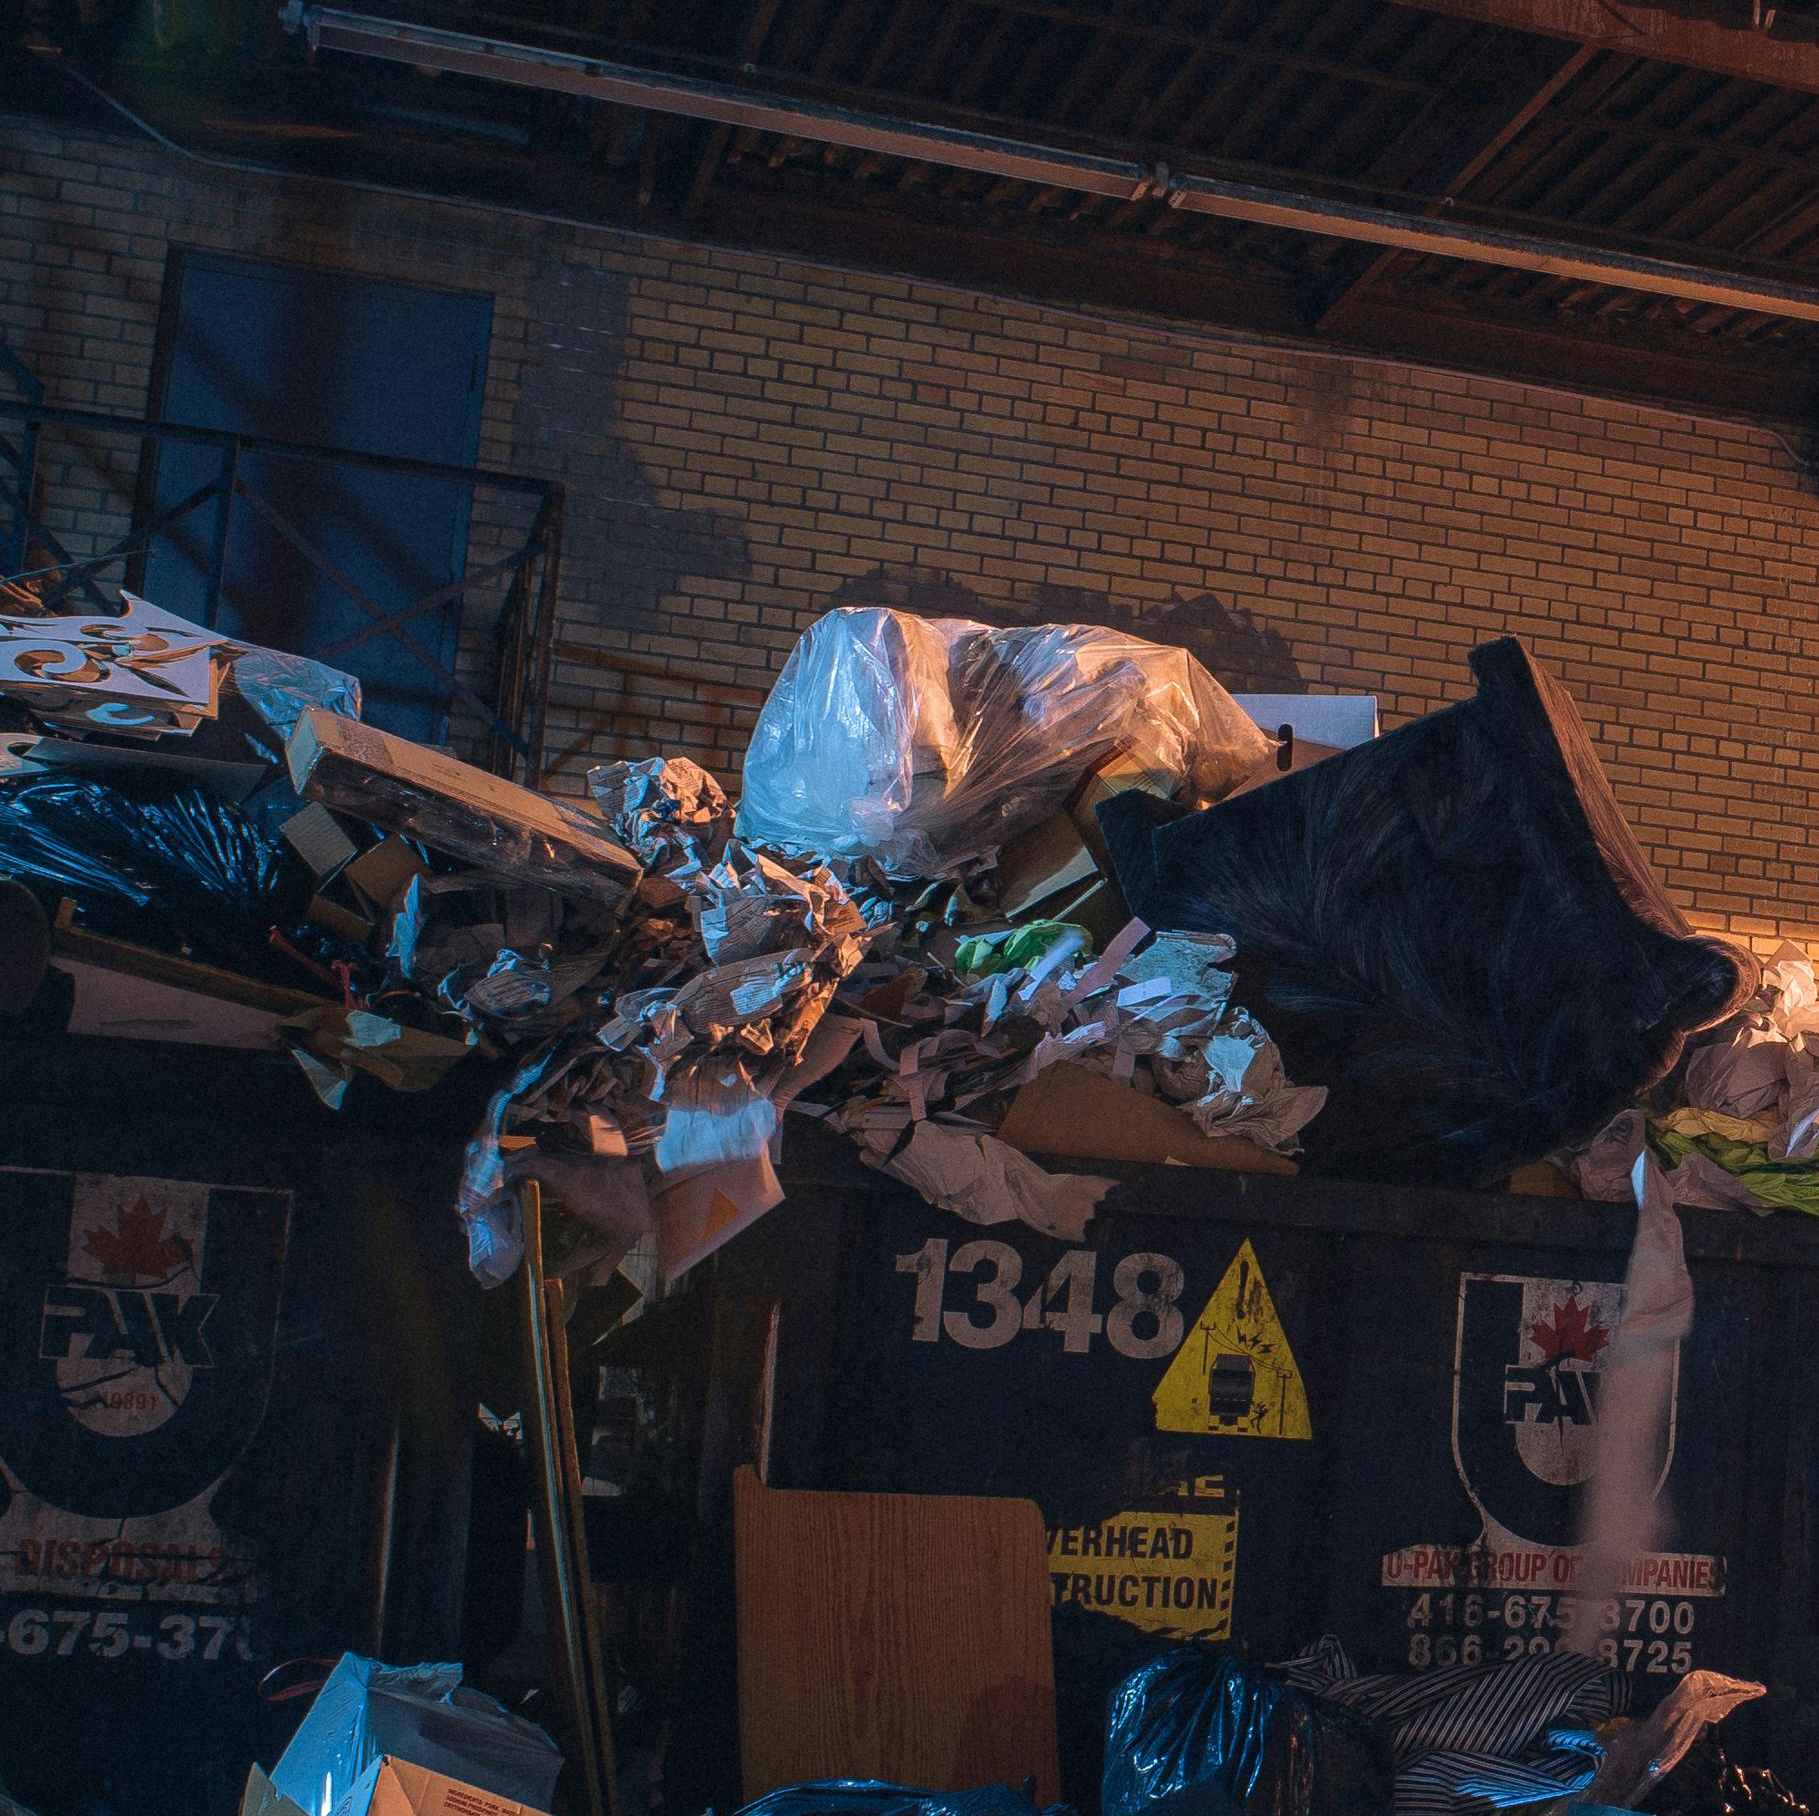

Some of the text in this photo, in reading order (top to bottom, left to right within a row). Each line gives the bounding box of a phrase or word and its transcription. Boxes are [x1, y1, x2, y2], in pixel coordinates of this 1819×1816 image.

[895, 1238, 1185, 1360] 1348
[1046, 1525, 1194, 1560] VERHEAD
[1386, 1549, 1459, 1582] U-PAK
[1467, 1550, 1548, 1583] GROUP
[1626, 1556, 1724, 1590] MPANIES
[1050, 1572, 1218, 1610] TRUCTION
